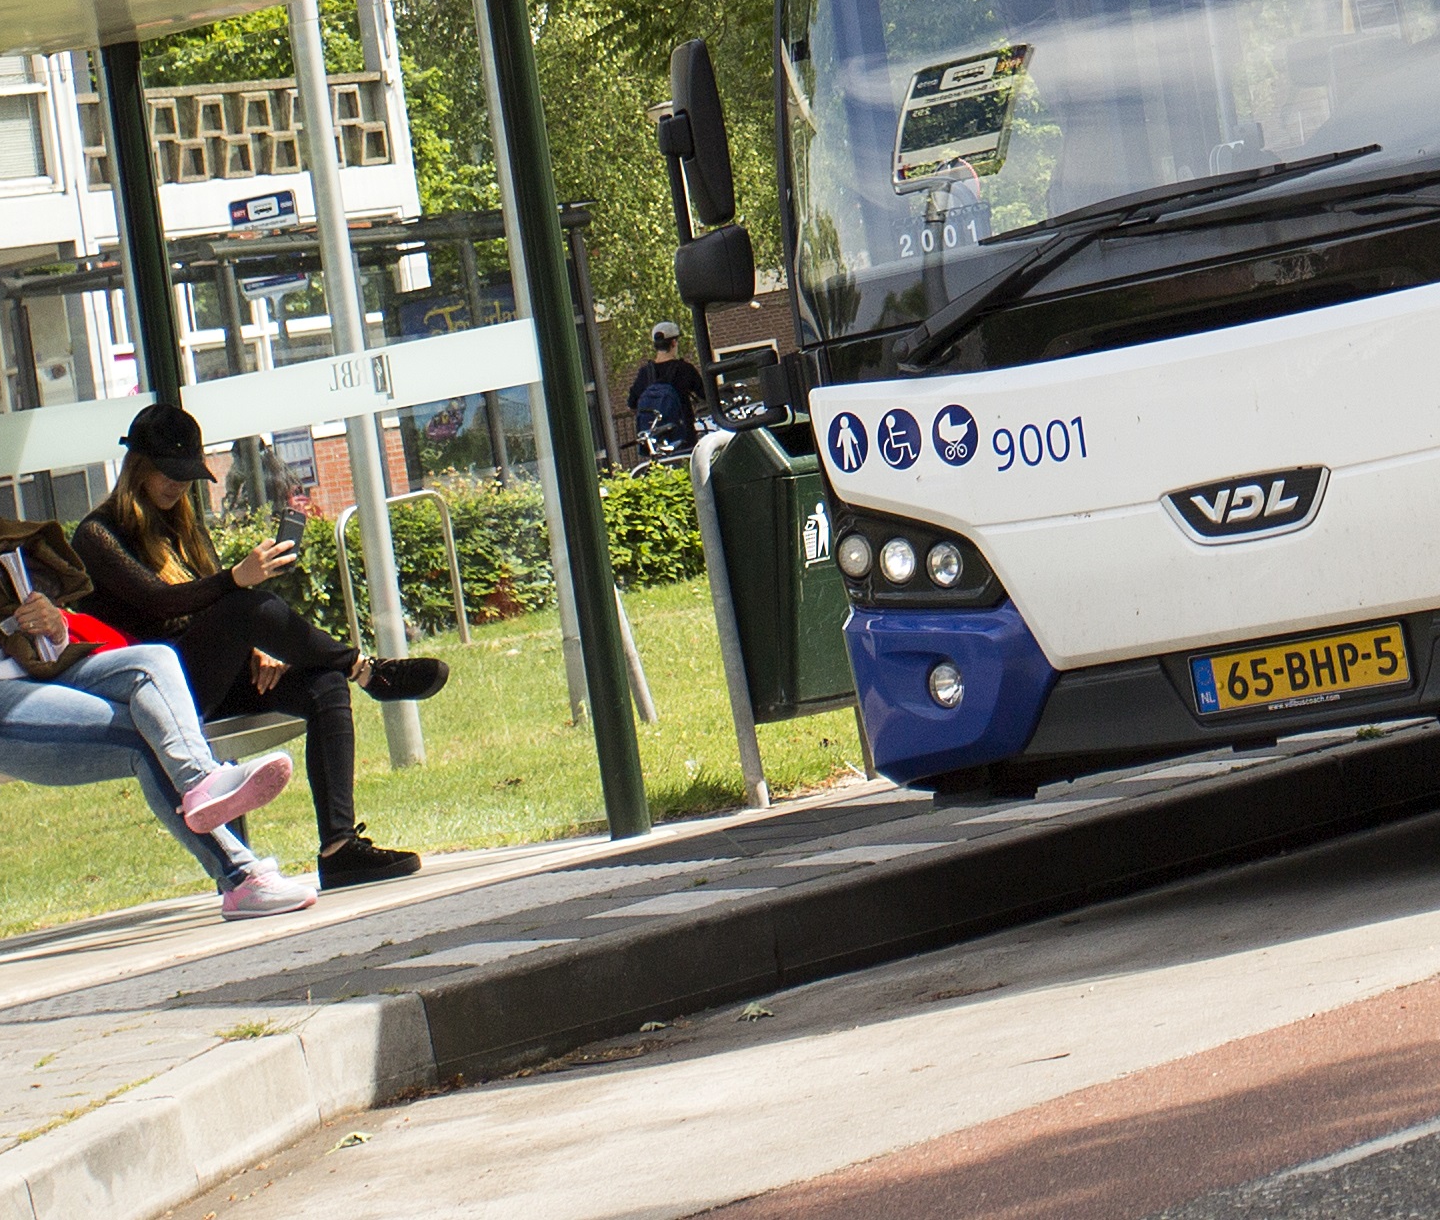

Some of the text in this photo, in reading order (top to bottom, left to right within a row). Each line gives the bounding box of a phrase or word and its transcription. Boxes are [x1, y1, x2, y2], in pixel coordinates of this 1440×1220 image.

[899, 219, 979, 258] 2001
[991, 415, 1088, 472] 9001
[1190, 479, 1299, 524] VDL
[1200, 635, 1399, 706] NL 65-BHP-5
